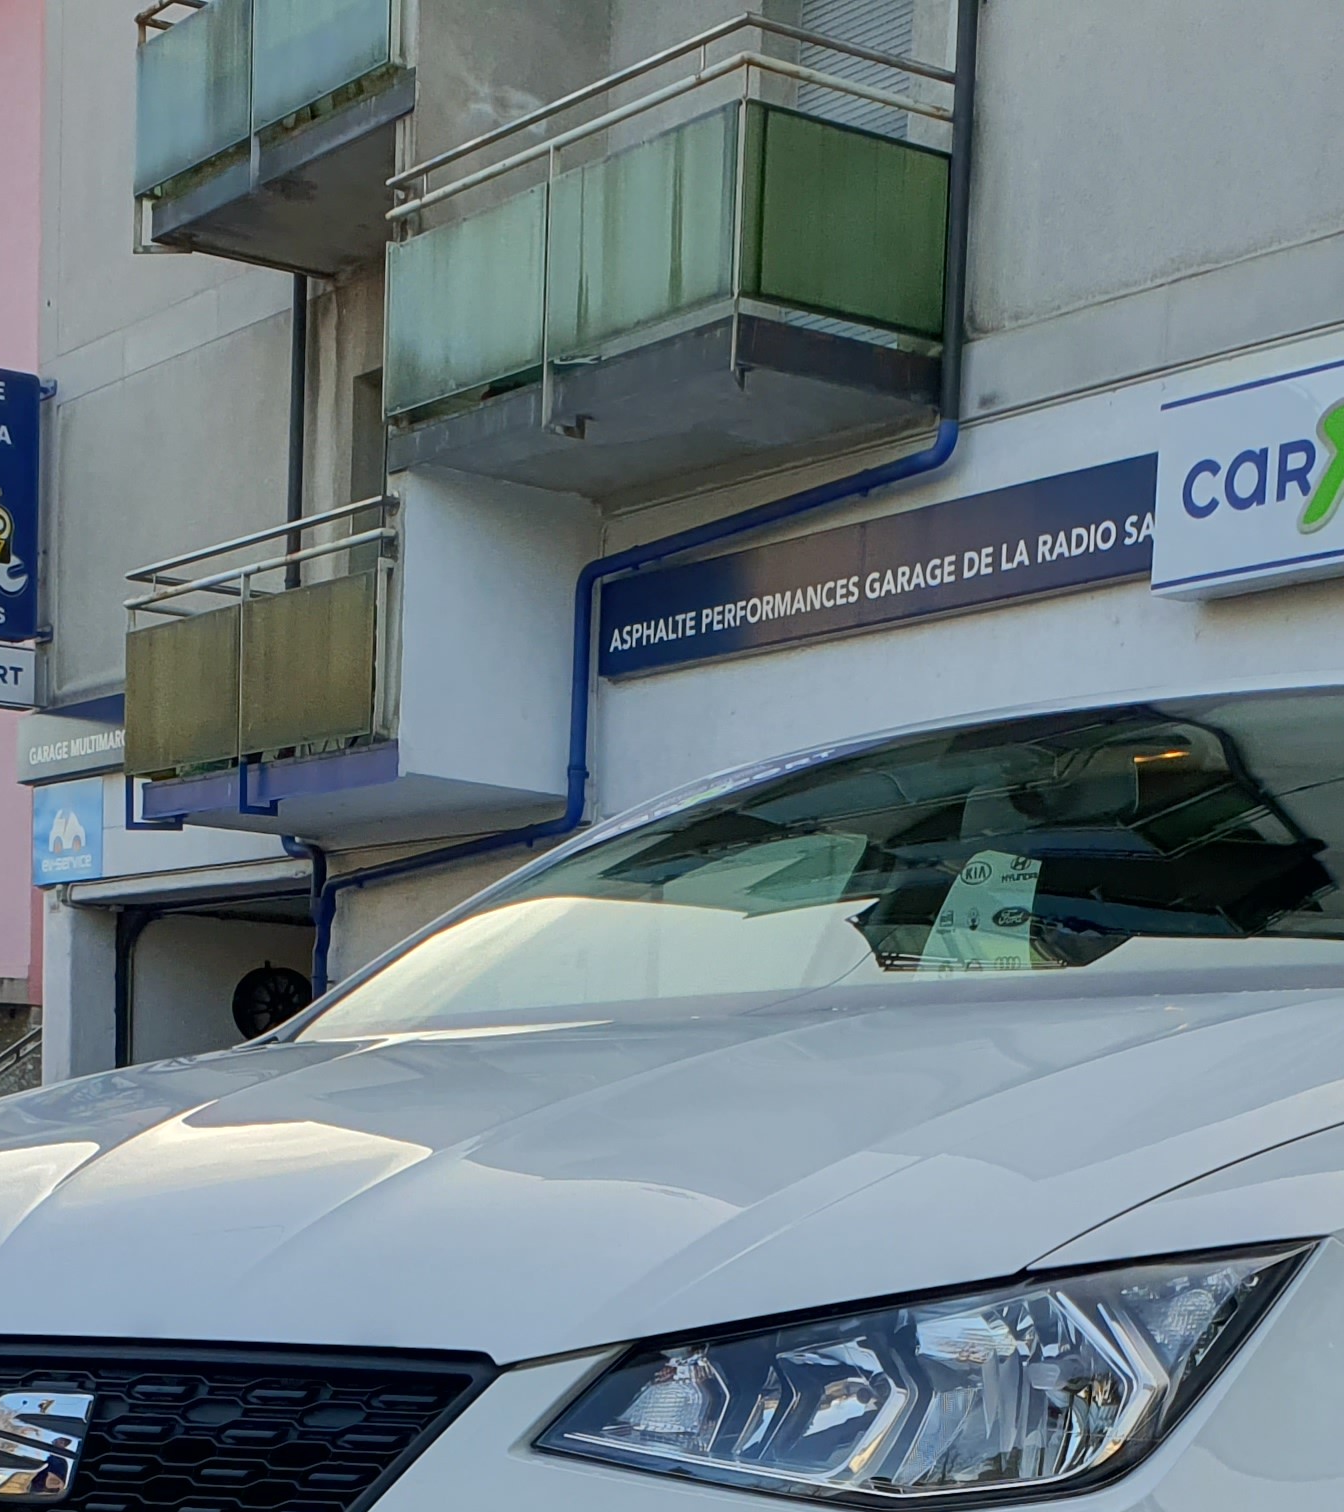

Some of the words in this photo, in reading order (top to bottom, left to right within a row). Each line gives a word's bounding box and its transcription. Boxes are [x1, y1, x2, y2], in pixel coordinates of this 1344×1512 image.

[609, 611, 696, 653] ASPHALTE
[701, 575, 859, 634] PERFORMANCES
[864, 555, 956, 599] GARAGE
[962, 546, 994, 579] DE
[1001, 539, 1030, 571] LA
[1037, 520, 1117, 564] RADIO
[1123, 511, 1155, 546] SA
[29, 741, 69, 765] GARAGE
[965, 865, 986, 880] KIA
[998, 909, 1025, 924] Ford
